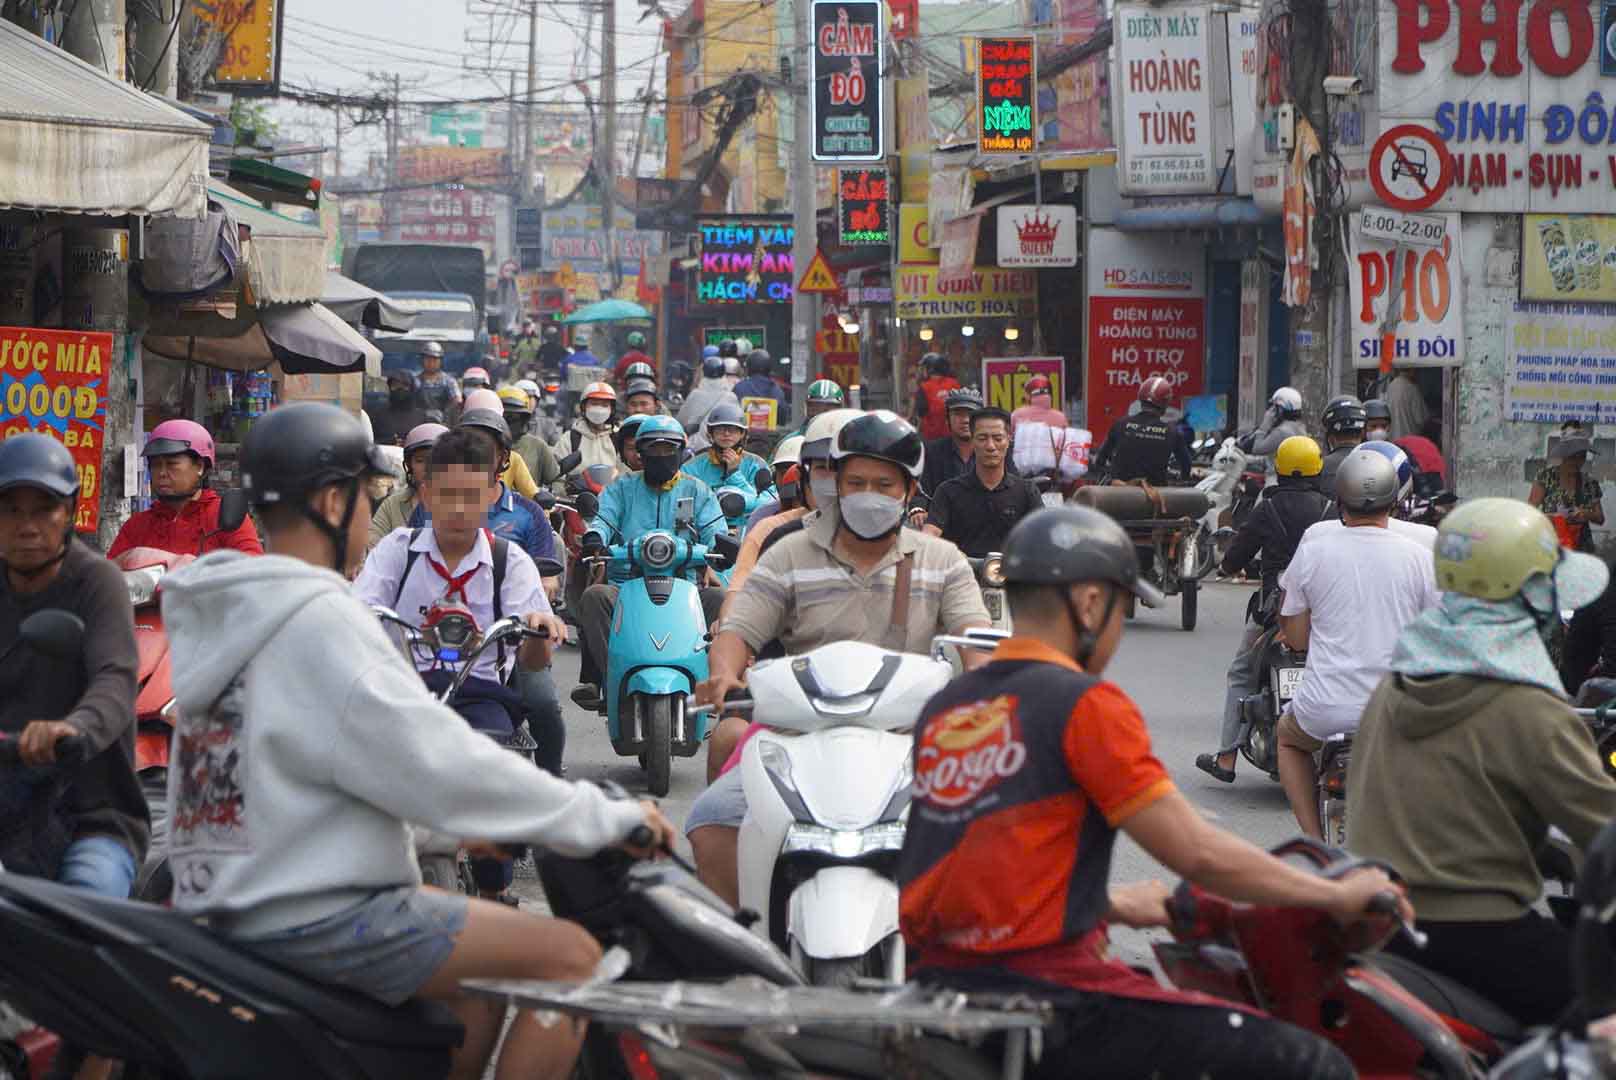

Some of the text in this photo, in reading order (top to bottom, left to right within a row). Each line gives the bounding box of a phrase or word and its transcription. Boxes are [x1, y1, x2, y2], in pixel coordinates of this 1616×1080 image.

[1167, 11, 1199, 37] MÁY
[1129, 50, 1201, 93] HOÀNG
[984, 99, 1031, 136] NỆM
[1139, 101, 1196, 145] TÙNG
[1435, 101, 1527, 144] SINH
[1528, 153, 1582, 198] SỤN
[702, 224, 754, 249] TIỆM
[702, 252, 753, 273] KIM
[920, 300, 977, 315] TRUNG
[56, 336, 102, 374] MÍA
[1143, 347, 1184, 367] TRỢ
[1359, 336, 1455, 359] SIH ĐÔI
